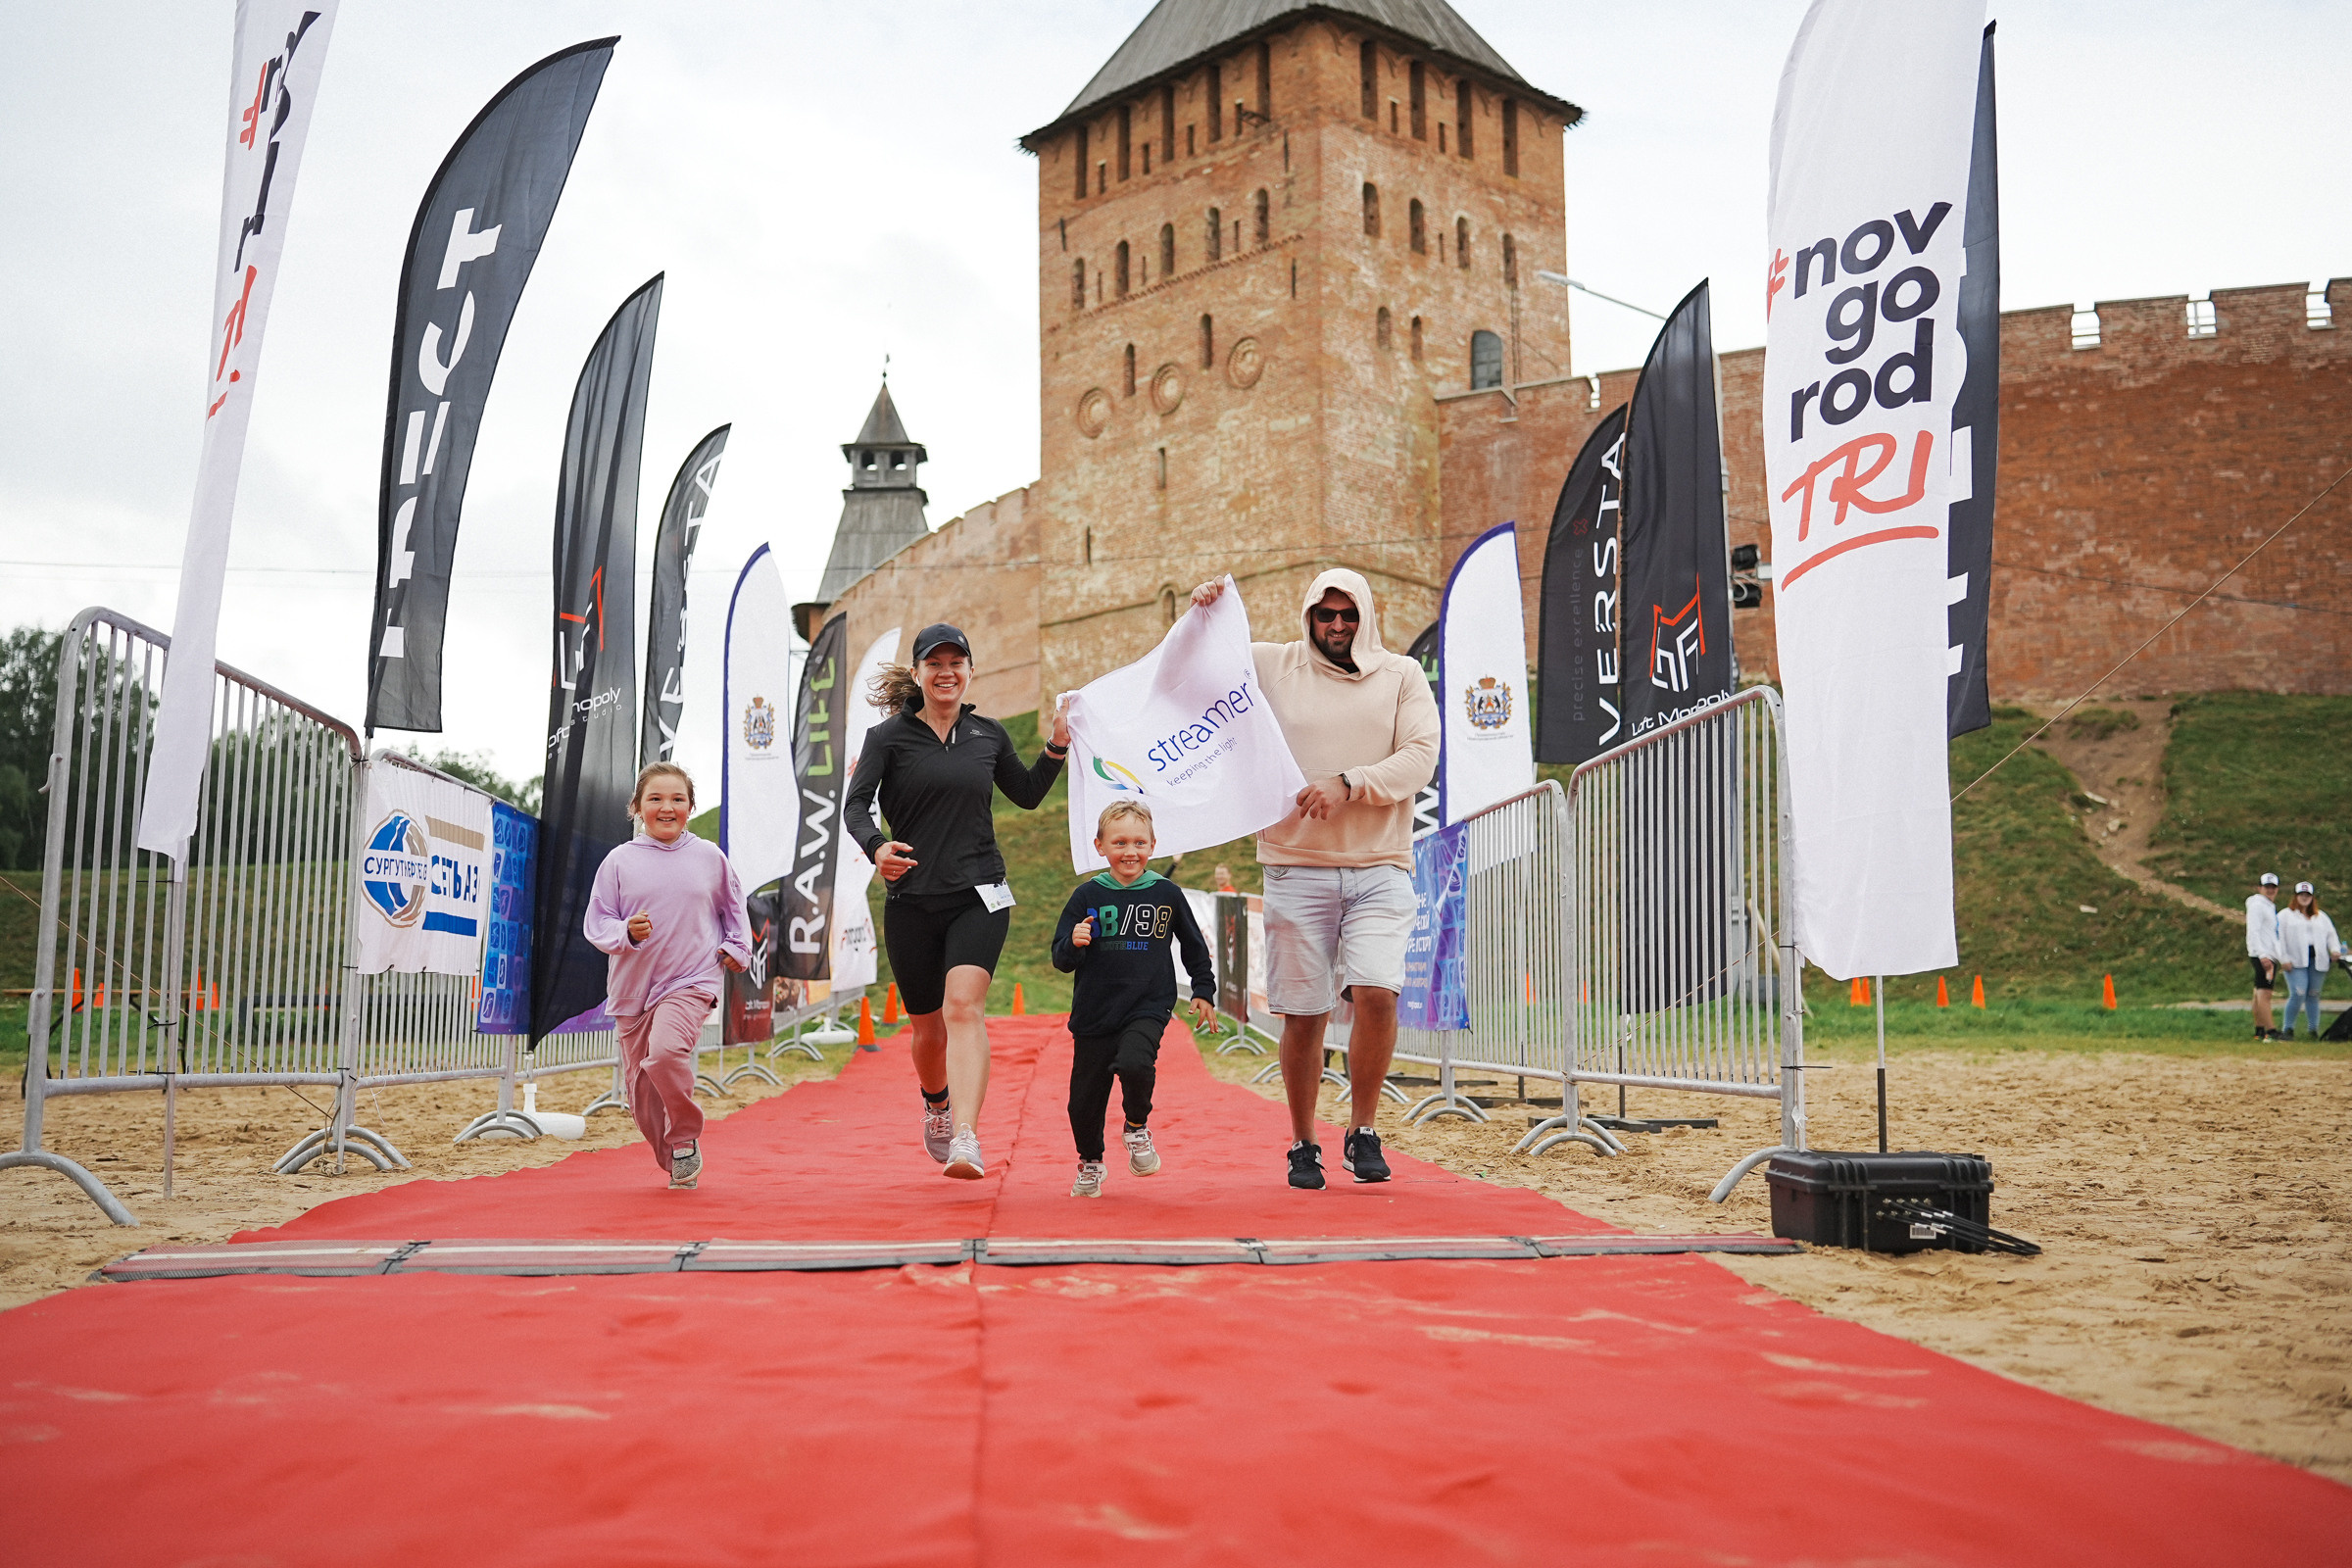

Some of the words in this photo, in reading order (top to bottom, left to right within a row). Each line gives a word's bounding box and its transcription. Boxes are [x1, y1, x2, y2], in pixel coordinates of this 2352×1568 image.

[1825, 266, 1940, 366] go
[1791, 318, 1935, 444] rod
[1781, 429, 1935, 542] TRI
[1569, 549, 1584, 647] excellence
[1593, 431, 1627, 746] VERSTA
[1572, 655, 1586, 721] precise
[1166, 760, 1208, 787] keeping
[1204, 748, 1222, 765] the
